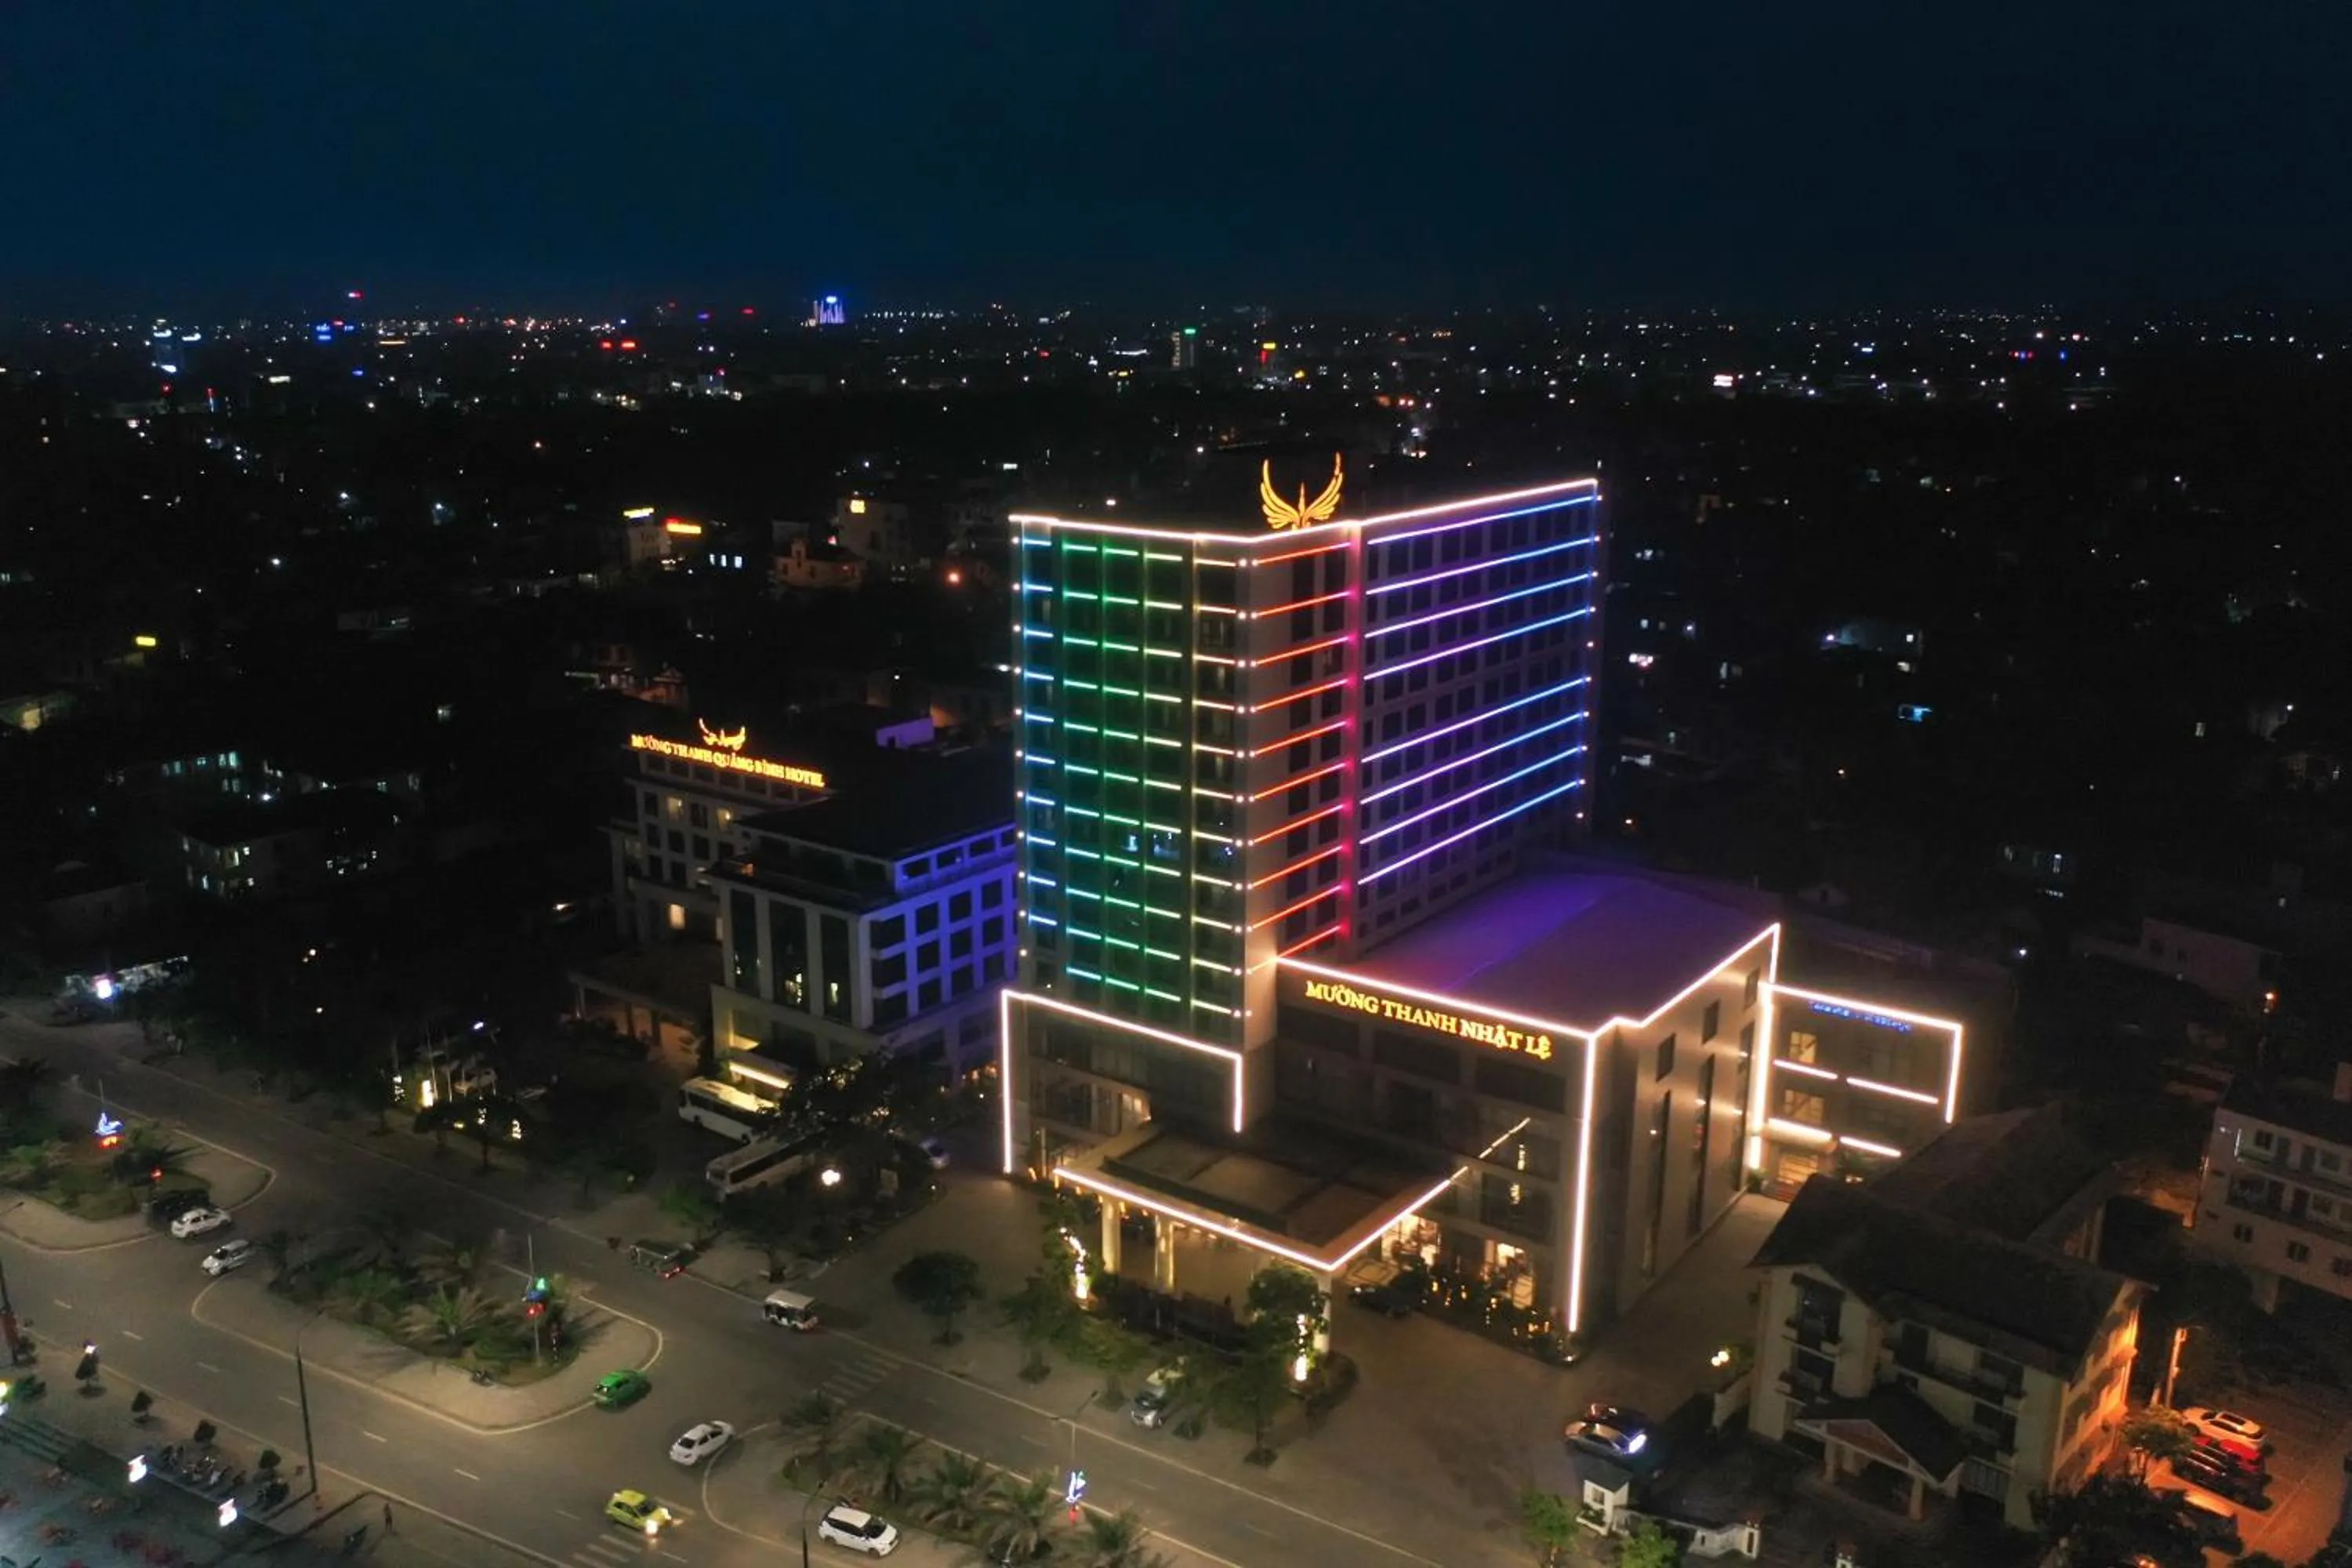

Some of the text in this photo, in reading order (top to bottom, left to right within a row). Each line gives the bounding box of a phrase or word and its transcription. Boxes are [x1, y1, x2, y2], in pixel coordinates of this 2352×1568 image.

[1305, 980, 1552, 1060] MƯỜNG THANH NHẬT LỆ
